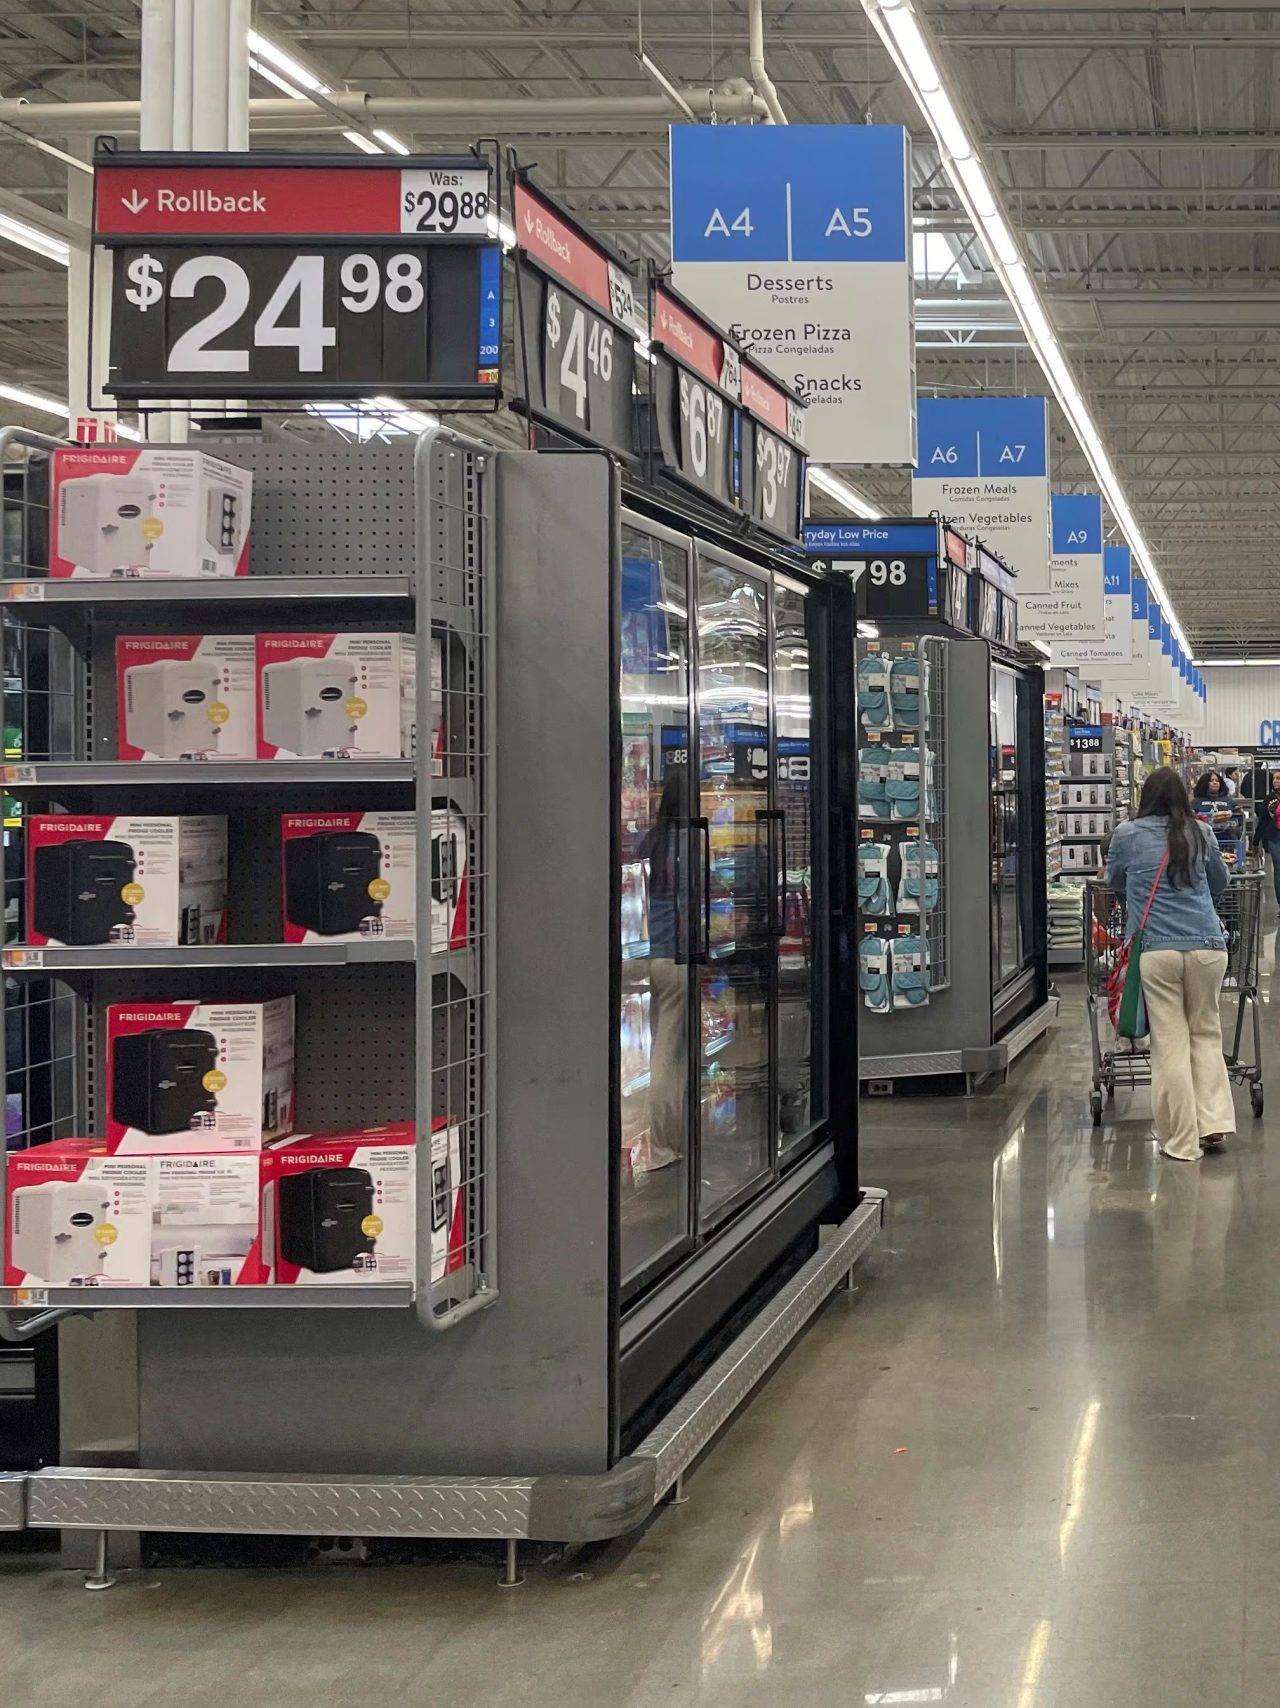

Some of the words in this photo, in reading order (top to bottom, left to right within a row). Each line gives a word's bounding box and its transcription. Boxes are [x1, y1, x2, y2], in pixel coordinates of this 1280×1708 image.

[429, 171, 464, 187] Was:
[157, 189, 267, 214] Rollback
[704, 207, 754, 238] A4
[824, 207, 872, 238] A5
[535, 217, 571, 264] Rollback
[747, 272, 834, 292] Desserts
[771, 294, 809, 304] Postres
[731, 324, 795, 340] Frozen
[804, 324, 850, 340] Pizza
[480, 345, 499, 355] 200
[749, 345, 772, 353] Pizza
[776, 345, 834, 355] Congeladas
[794, 373, 862, 392] Snacks
[804, 395, 843, 405] geladas
[931, 446, 958, 464] A6
[999, 445, 1026, 463] A7
[62, 455, 128, 465] FRIGIDAIRE
[943, 484, 980, 494] Frozen
[984, 484, 1016, 494] Meals
[940, 515, 965, 523] ozen
[969, 513, 1032, 525] Vegetables
[804, 529, 836, 541] ryday
[839, 529, 859, 539] Low
[863, 529, 888, 539] Price
[1067, 530, 1088, 544] A9
[1054, 580, 1079, 589] Mixes
[1048, 623, 1095, 631] Vegetables
[125, 640, 189, 651] FRIGIDAIRE
[264, 638, 324, 649] FRIGIDAIRE
[40, 823, 103, 832] FRIGIDAIRE
[288, 818, 351, 828] FRIGIDAIRE
[119, 1012, 182, 1022] FRIGIDAIRE
[281, 1153, 344, 1164] FRIGIDAIRE
[16, 1162, 78, 1172] FRIGIDAIRE
[160, 1160, 215, 1169] FRIGIDAIRE
